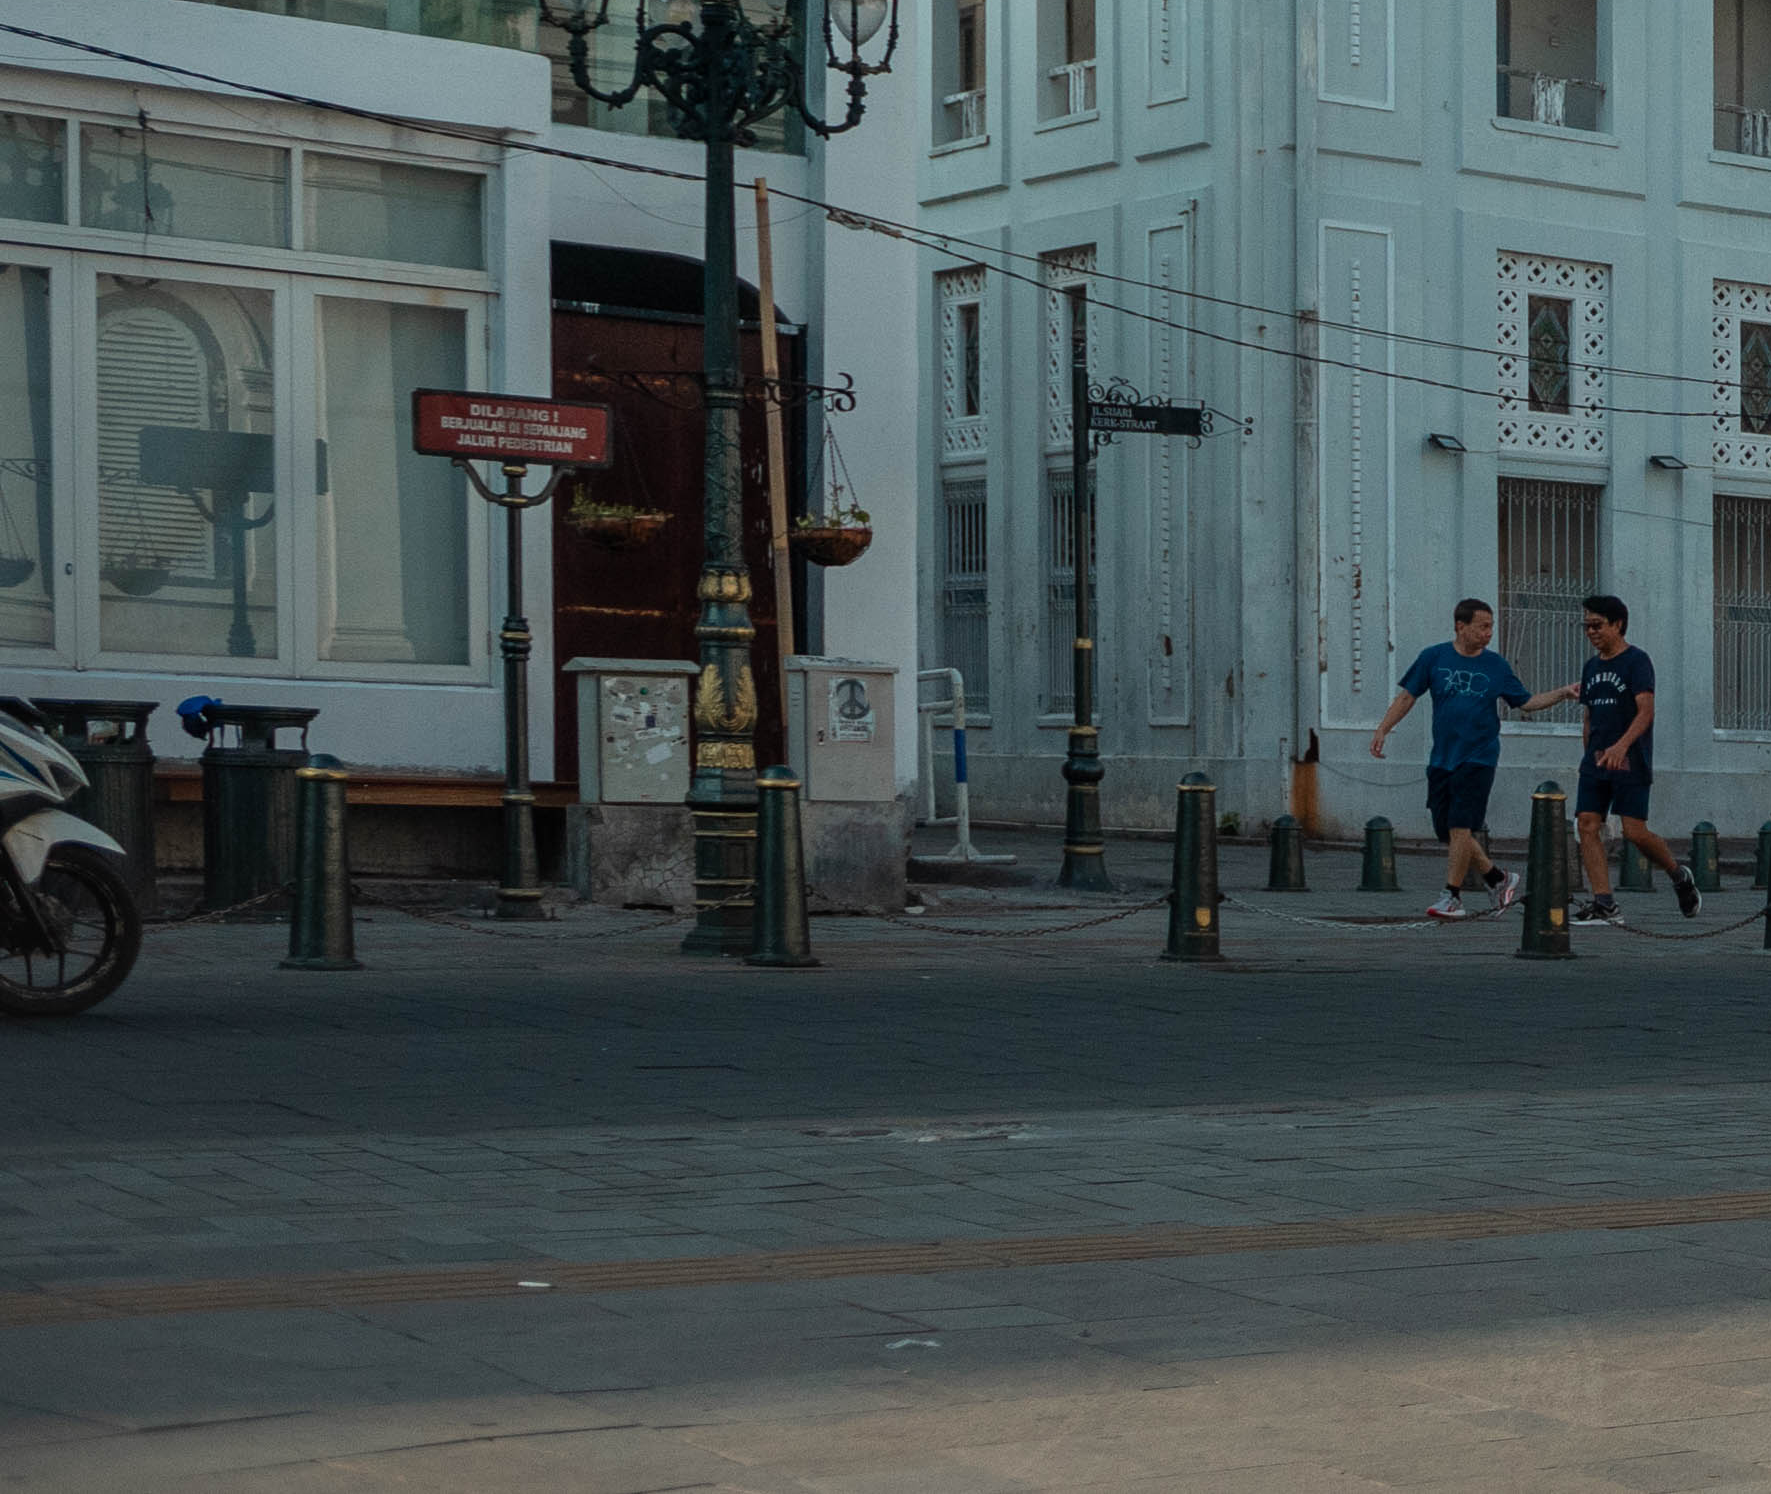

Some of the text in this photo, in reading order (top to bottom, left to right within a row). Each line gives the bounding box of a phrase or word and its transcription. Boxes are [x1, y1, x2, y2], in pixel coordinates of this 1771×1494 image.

[470, 404, 549, 422] DILARANG
[440, 416, 588, 439] BERJUALAN DI SEPANJANG
[457, 434, 572, 454] JALUR PEDESTRIAN
